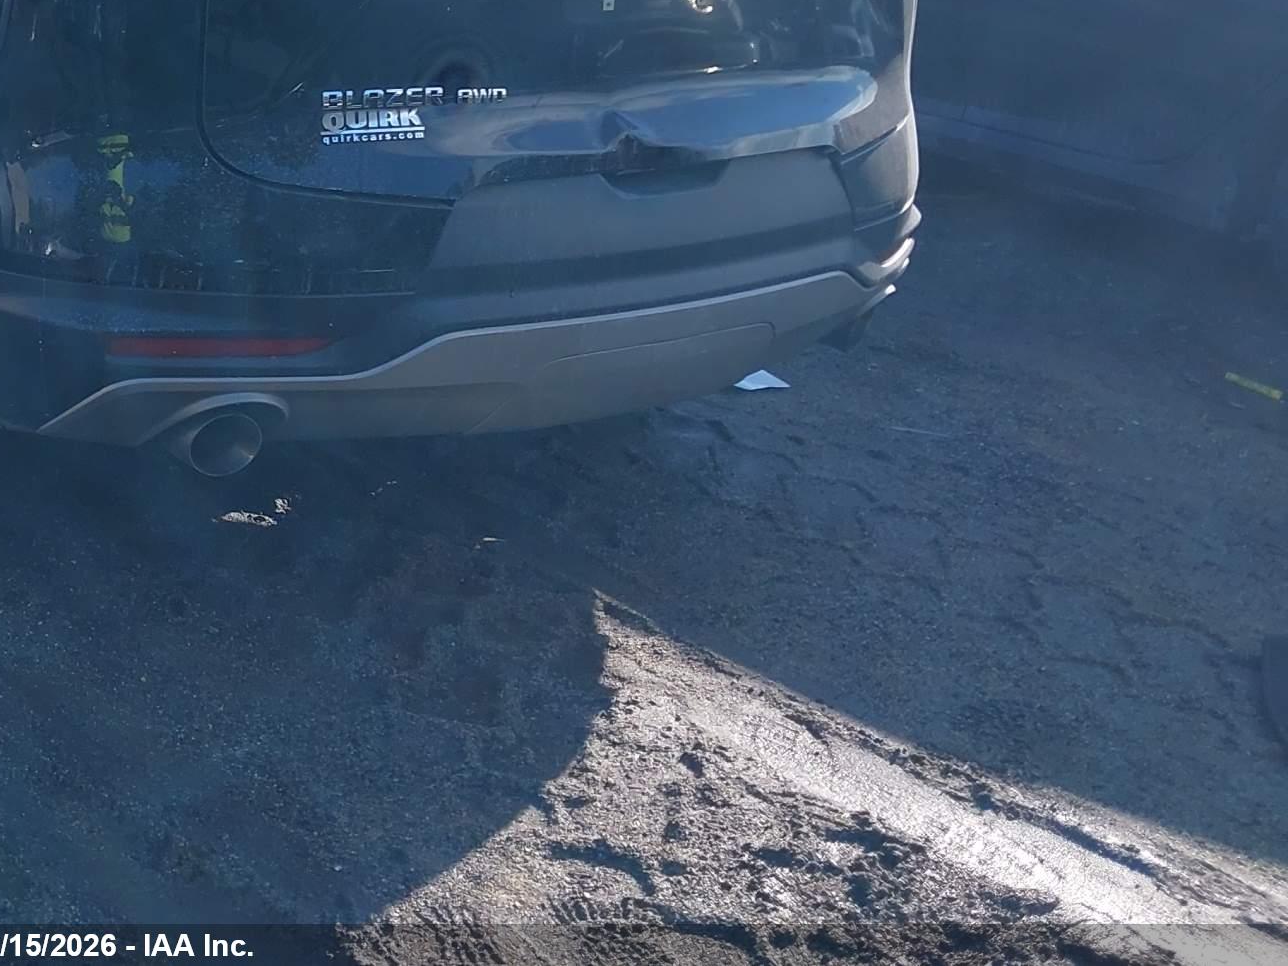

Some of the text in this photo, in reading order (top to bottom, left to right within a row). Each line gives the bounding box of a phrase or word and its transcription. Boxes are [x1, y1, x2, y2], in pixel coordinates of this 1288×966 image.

[322, 87, 507, 109] BLAZER AWD
[321, 108, 422, 133] QUIRK
[322, 131, 425, 145] quirkcars.com
